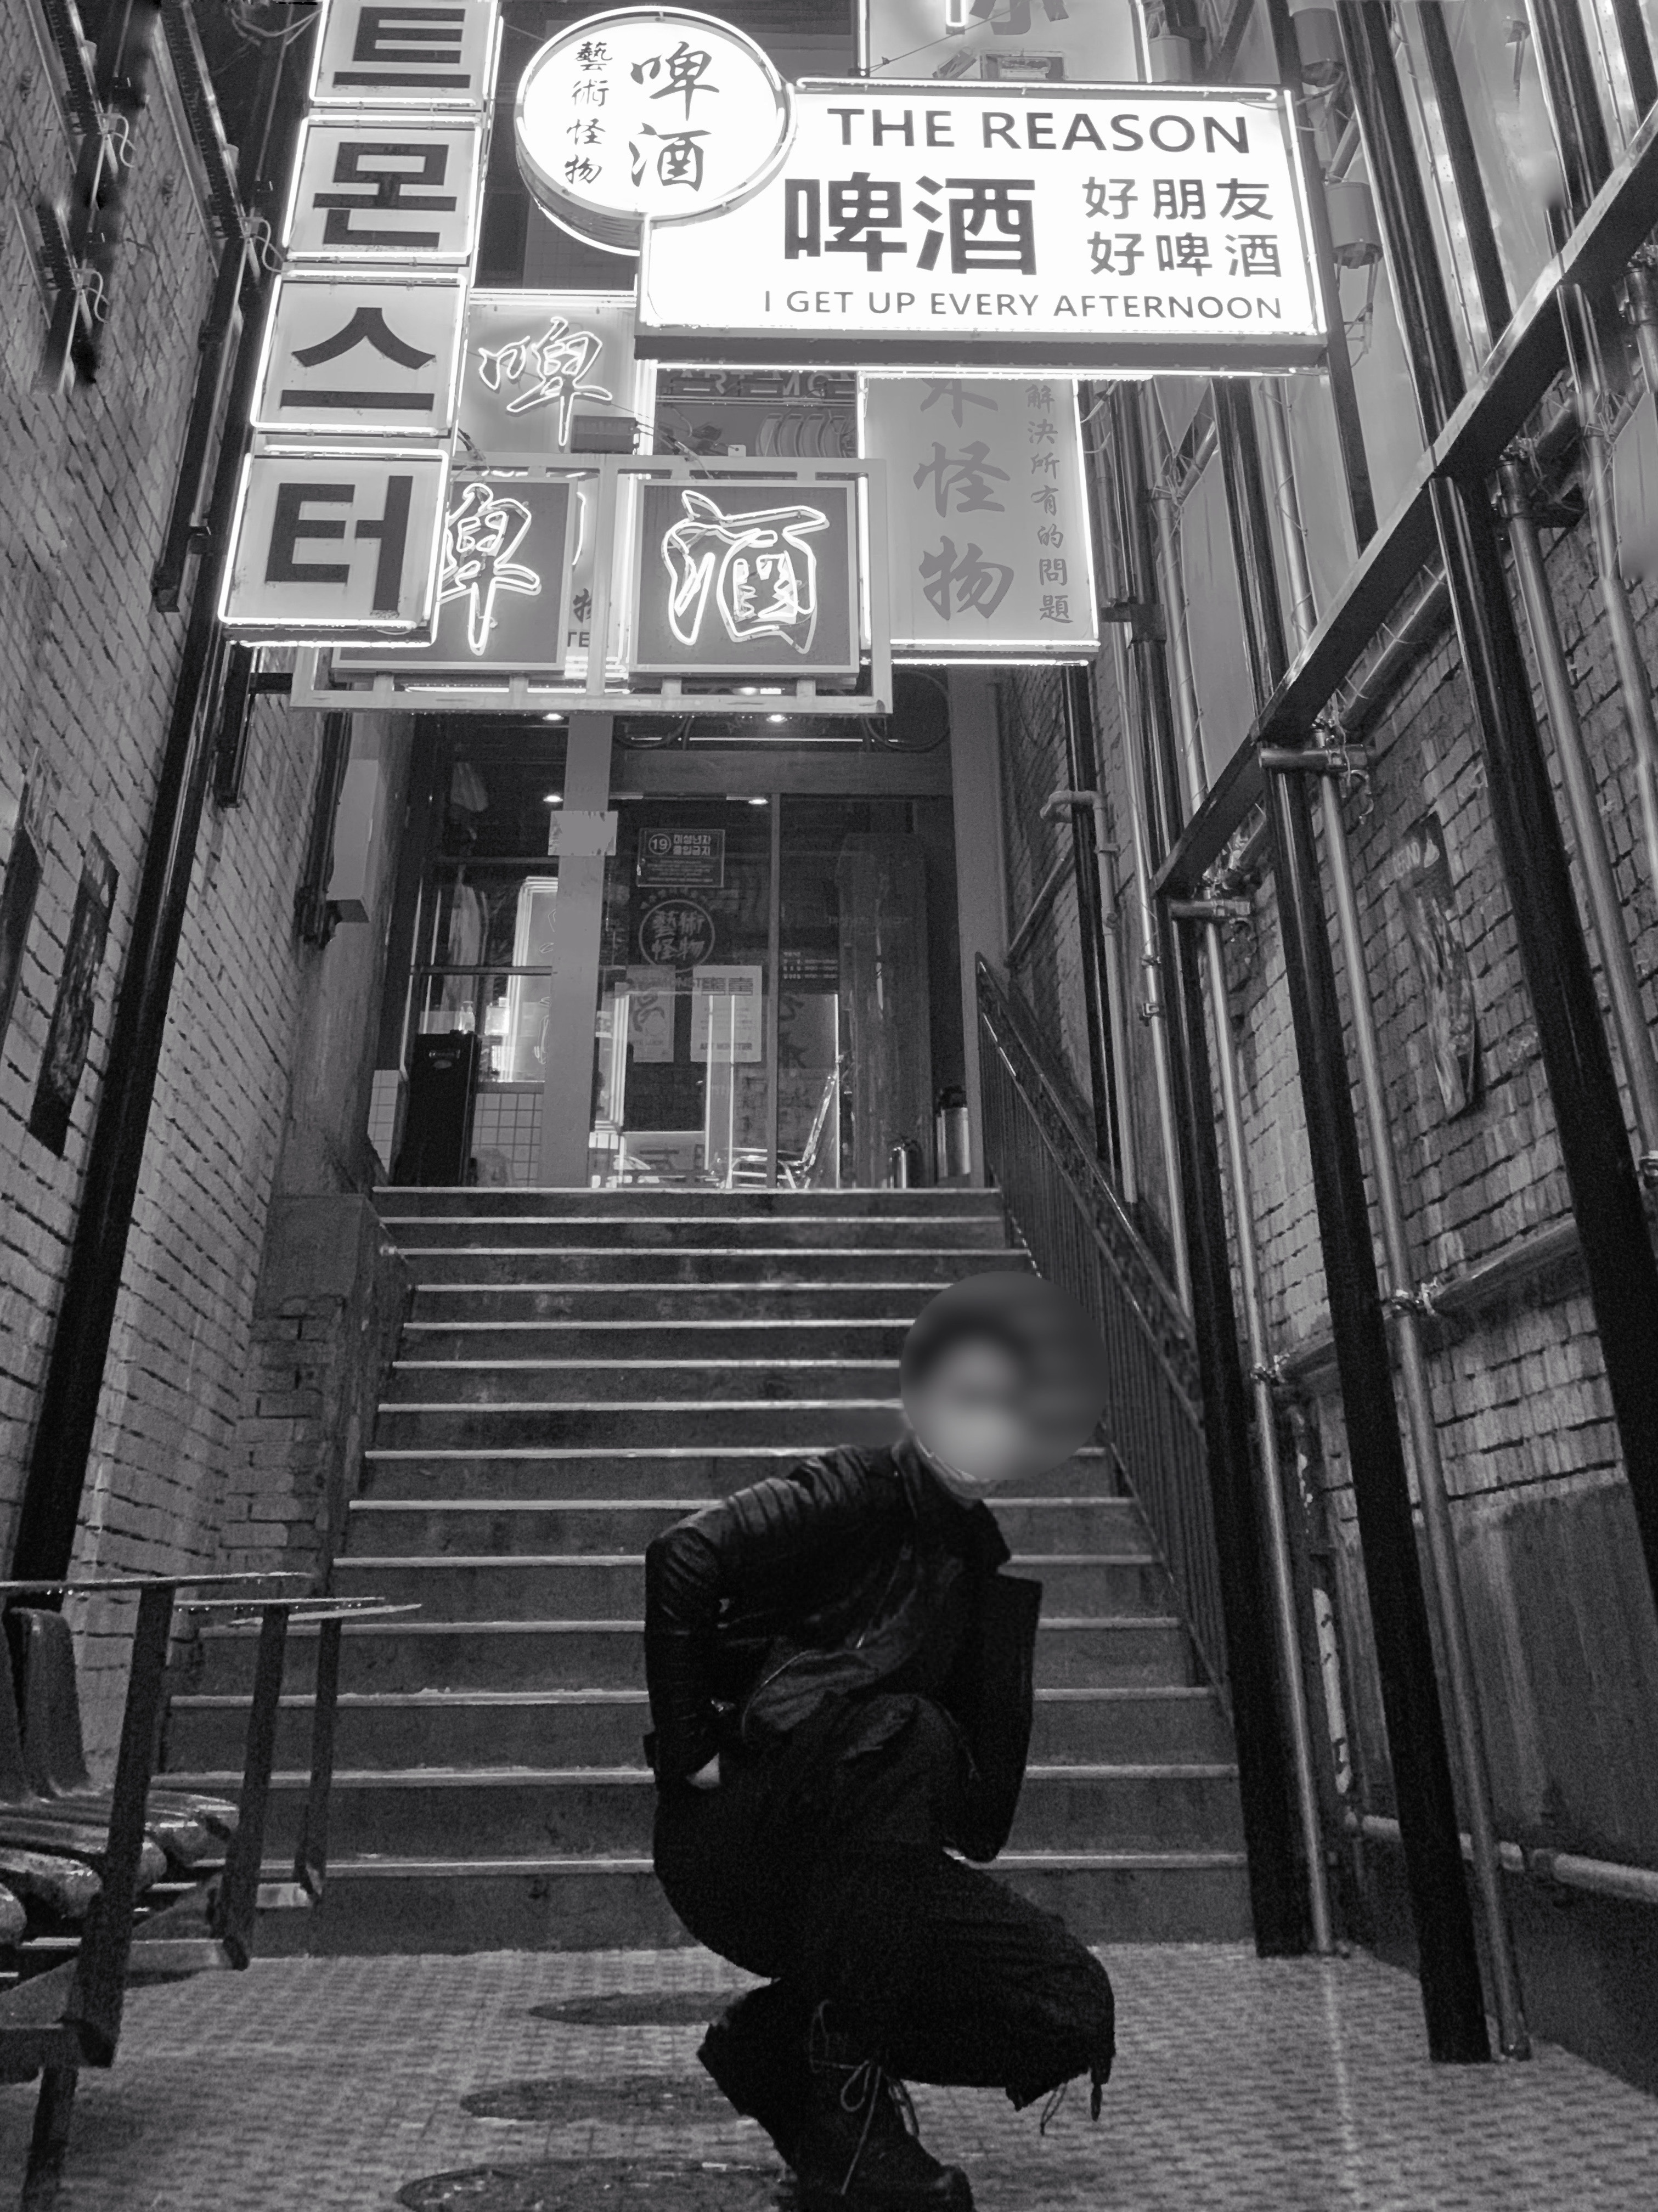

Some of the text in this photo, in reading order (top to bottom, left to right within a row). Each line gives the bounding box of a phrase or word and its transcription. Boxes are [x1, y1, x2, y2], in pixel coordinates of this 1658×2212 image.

[563, 42, 613, 184] 藝術怪物
[628, 42, 720, 192] 啤酒
[827, 108, 1249, 154] THE REASON
[1082, 176, 1273, 221] 好朋友
[784, 171, 1037, 275] 啤酒
[1087, 231, 1282, 277] 好啤酒
[765, 290, 1281, 319] I GET UP EVERY AFTERNOON
[1025, 383, 1074, 624] 解決所有的問題
[652, 838, 668, 850] 19
